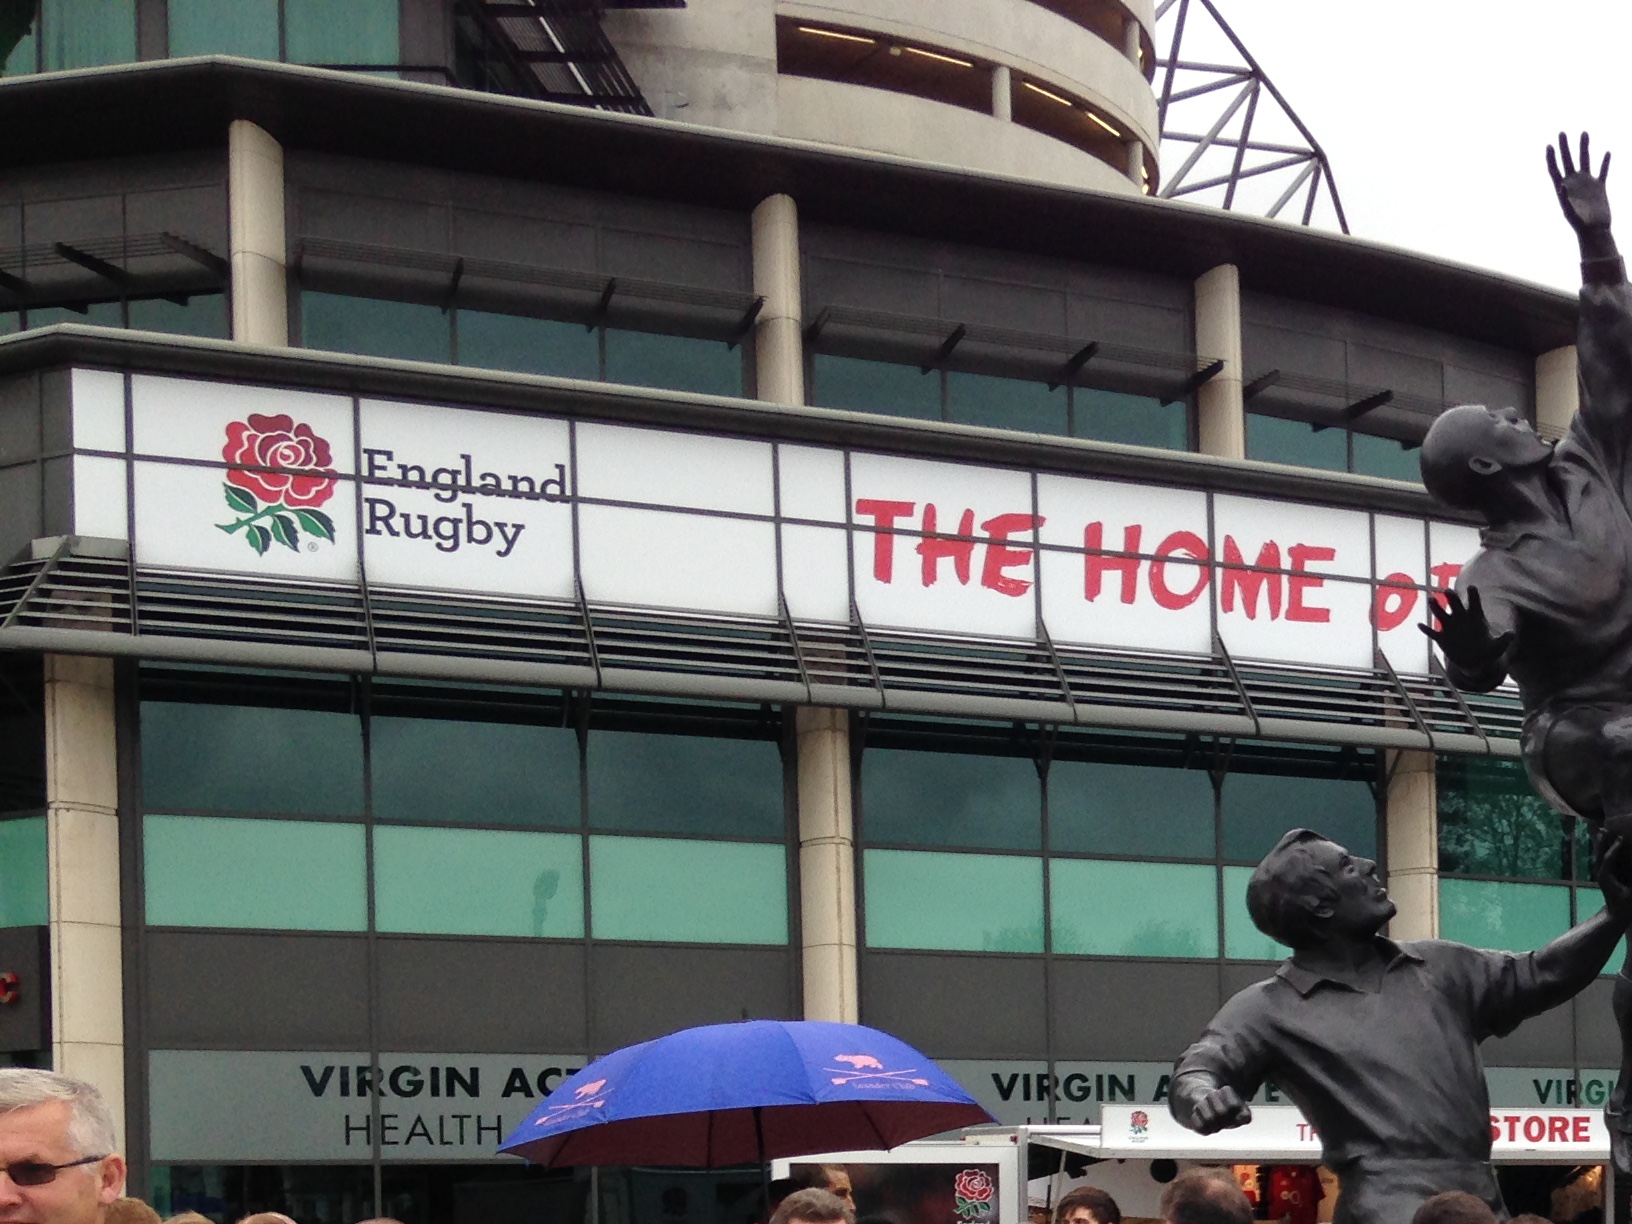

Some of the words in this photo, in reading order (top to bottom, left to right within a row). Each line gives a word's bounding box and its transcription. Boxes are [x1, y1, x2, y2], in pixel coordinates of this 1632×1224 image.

[363, 448, 571, 503] England
[364, 498, 525, 558] Rugby
[856, 498, 1046, 597] THE
[1084, 521, 1337, 623] HOME
[300, 1066, 480, 1098] VIRGIN
[991, 1073, 1136, 1102] VIRGIN
[345, 1114, 502, 1145] HEALTH
[1490, 1115, 1591, 1142] STORE
